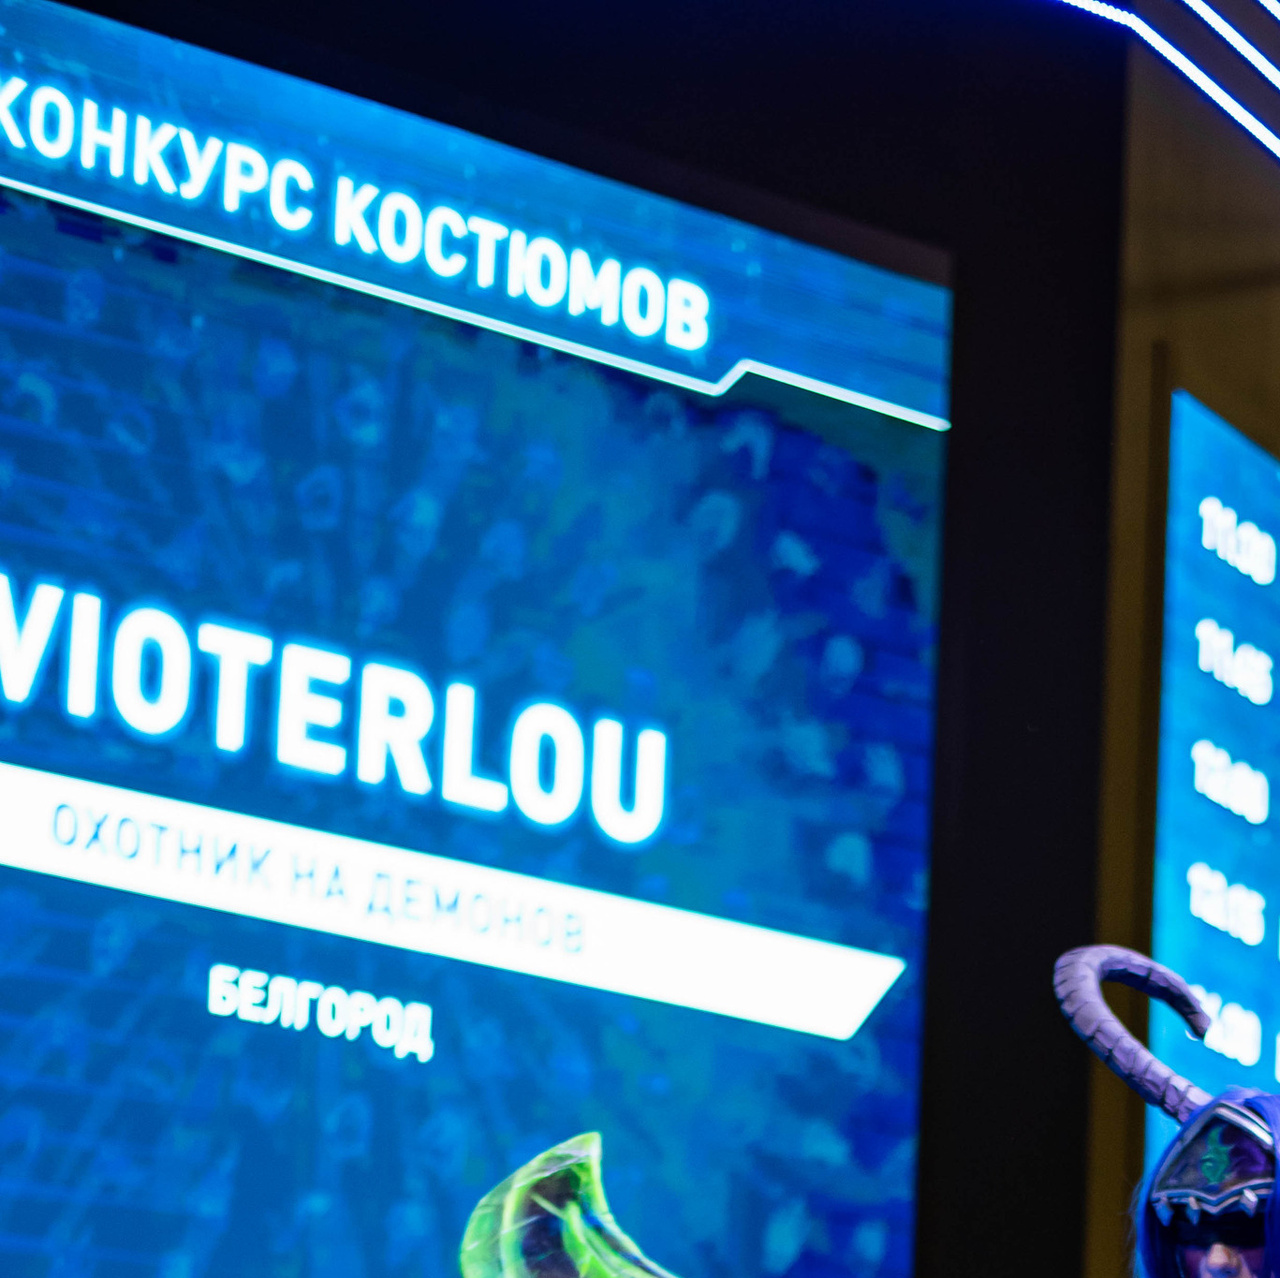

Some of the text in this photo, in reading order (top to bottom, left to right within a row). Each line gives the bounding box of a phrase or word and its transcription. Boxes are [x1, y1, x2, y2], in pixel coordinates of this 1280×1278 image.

[333, 175, 711, 351] КОСТЮМОВ
[0, 571, 667, 844] VIOTERLOU
[51, 800, 585, 955] ОХОТНИК НА ДЕМОНОВ
[207, 963, 435, 1063] БЕЛГОРОД
